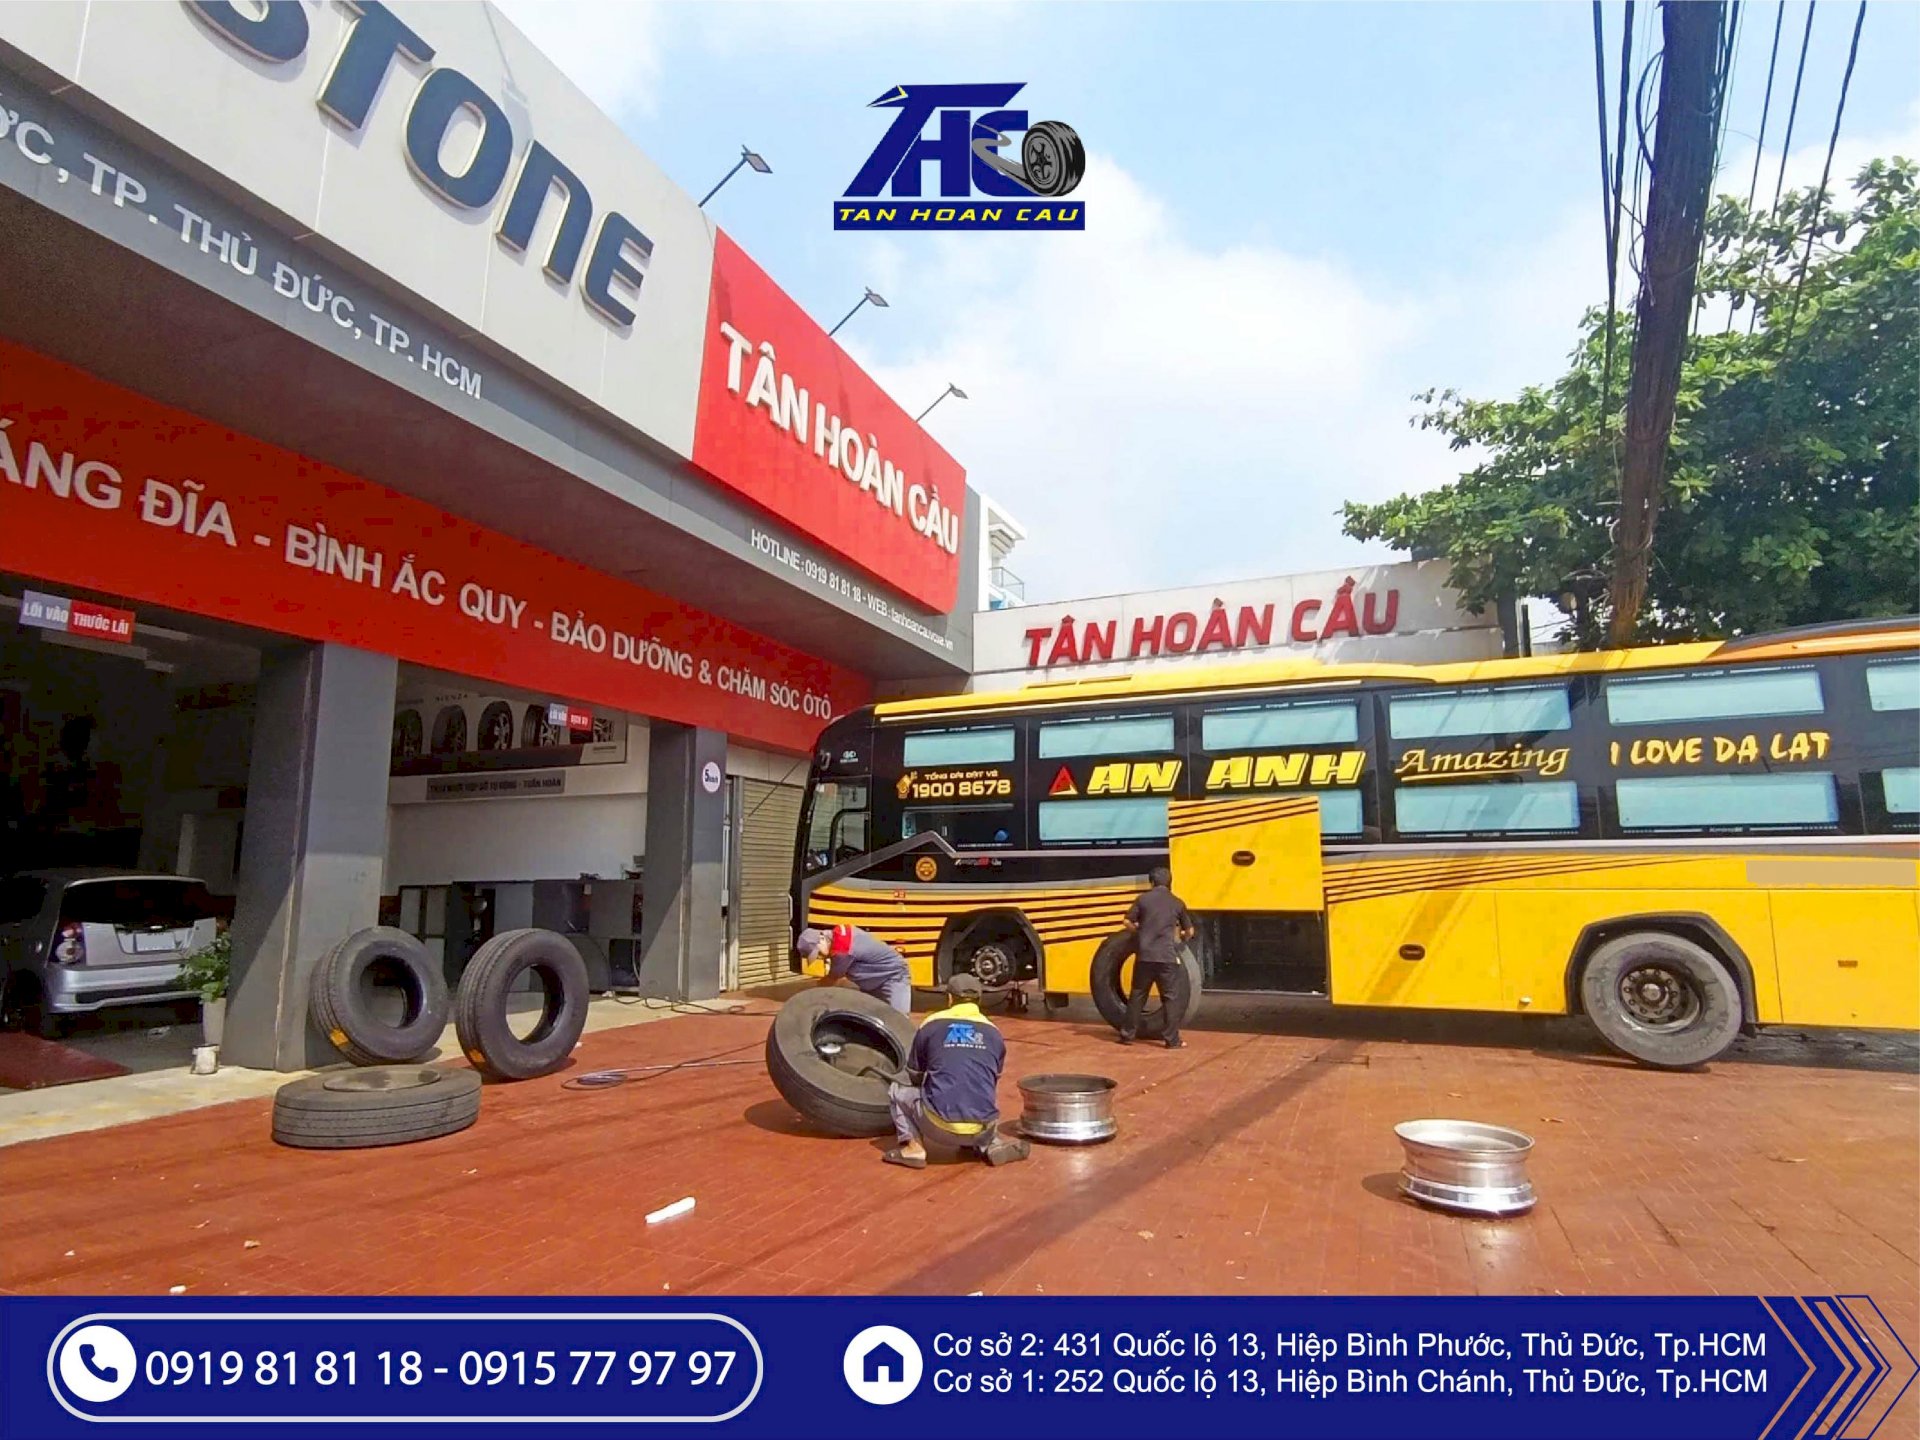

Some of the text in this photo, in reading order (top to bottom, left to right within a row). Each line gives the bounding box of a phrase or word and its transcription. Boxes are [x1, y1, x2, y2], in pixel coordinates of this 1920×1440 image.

[83, 152, 159, 225] TP.
[174, 203, 258, 276] THỦ
[272, 261, 362, 339] ĐỨC,
[369, 313, 414, 362] TP.
[421, 343, 483, 400] HCM
[720, 321, 809, 444] TÂN
[814, 402, 904, 517] HOÀN
[139, 478, 237, 547] ĐĨA
[284, 522, 383, 588] BÌNH
[391, 553, 446, 606] ẮC
[460, 582, 528, 629] QUY
[551, 610, 607, 653] BẢO
[612, 636, 694, 679] DƯỠNG
[698, 659, 713, 685] &
[717, 666, 766, 701] CHĂM
[770, 680, 800, 711] SÓC
[805, 559, 828, 585] 0919
[829, 571, 840, 592] 81
[841, 579, 851, 597] 81
[852, 585, 862, 603] 18
[45, 605, 69, 623] VÀO
[111, 619, 129, 634] LÁI
[1025, 575, 1399, 669] TÂN HOÀN CẦU
[1395, 743, 1570, 776] Amazing
[1610, 732, 1831, 766] I LOVE DA LAT
[912, 779, 1011, 799] 1900 8678
[1087, 751, 1366, 795] AN ANH
